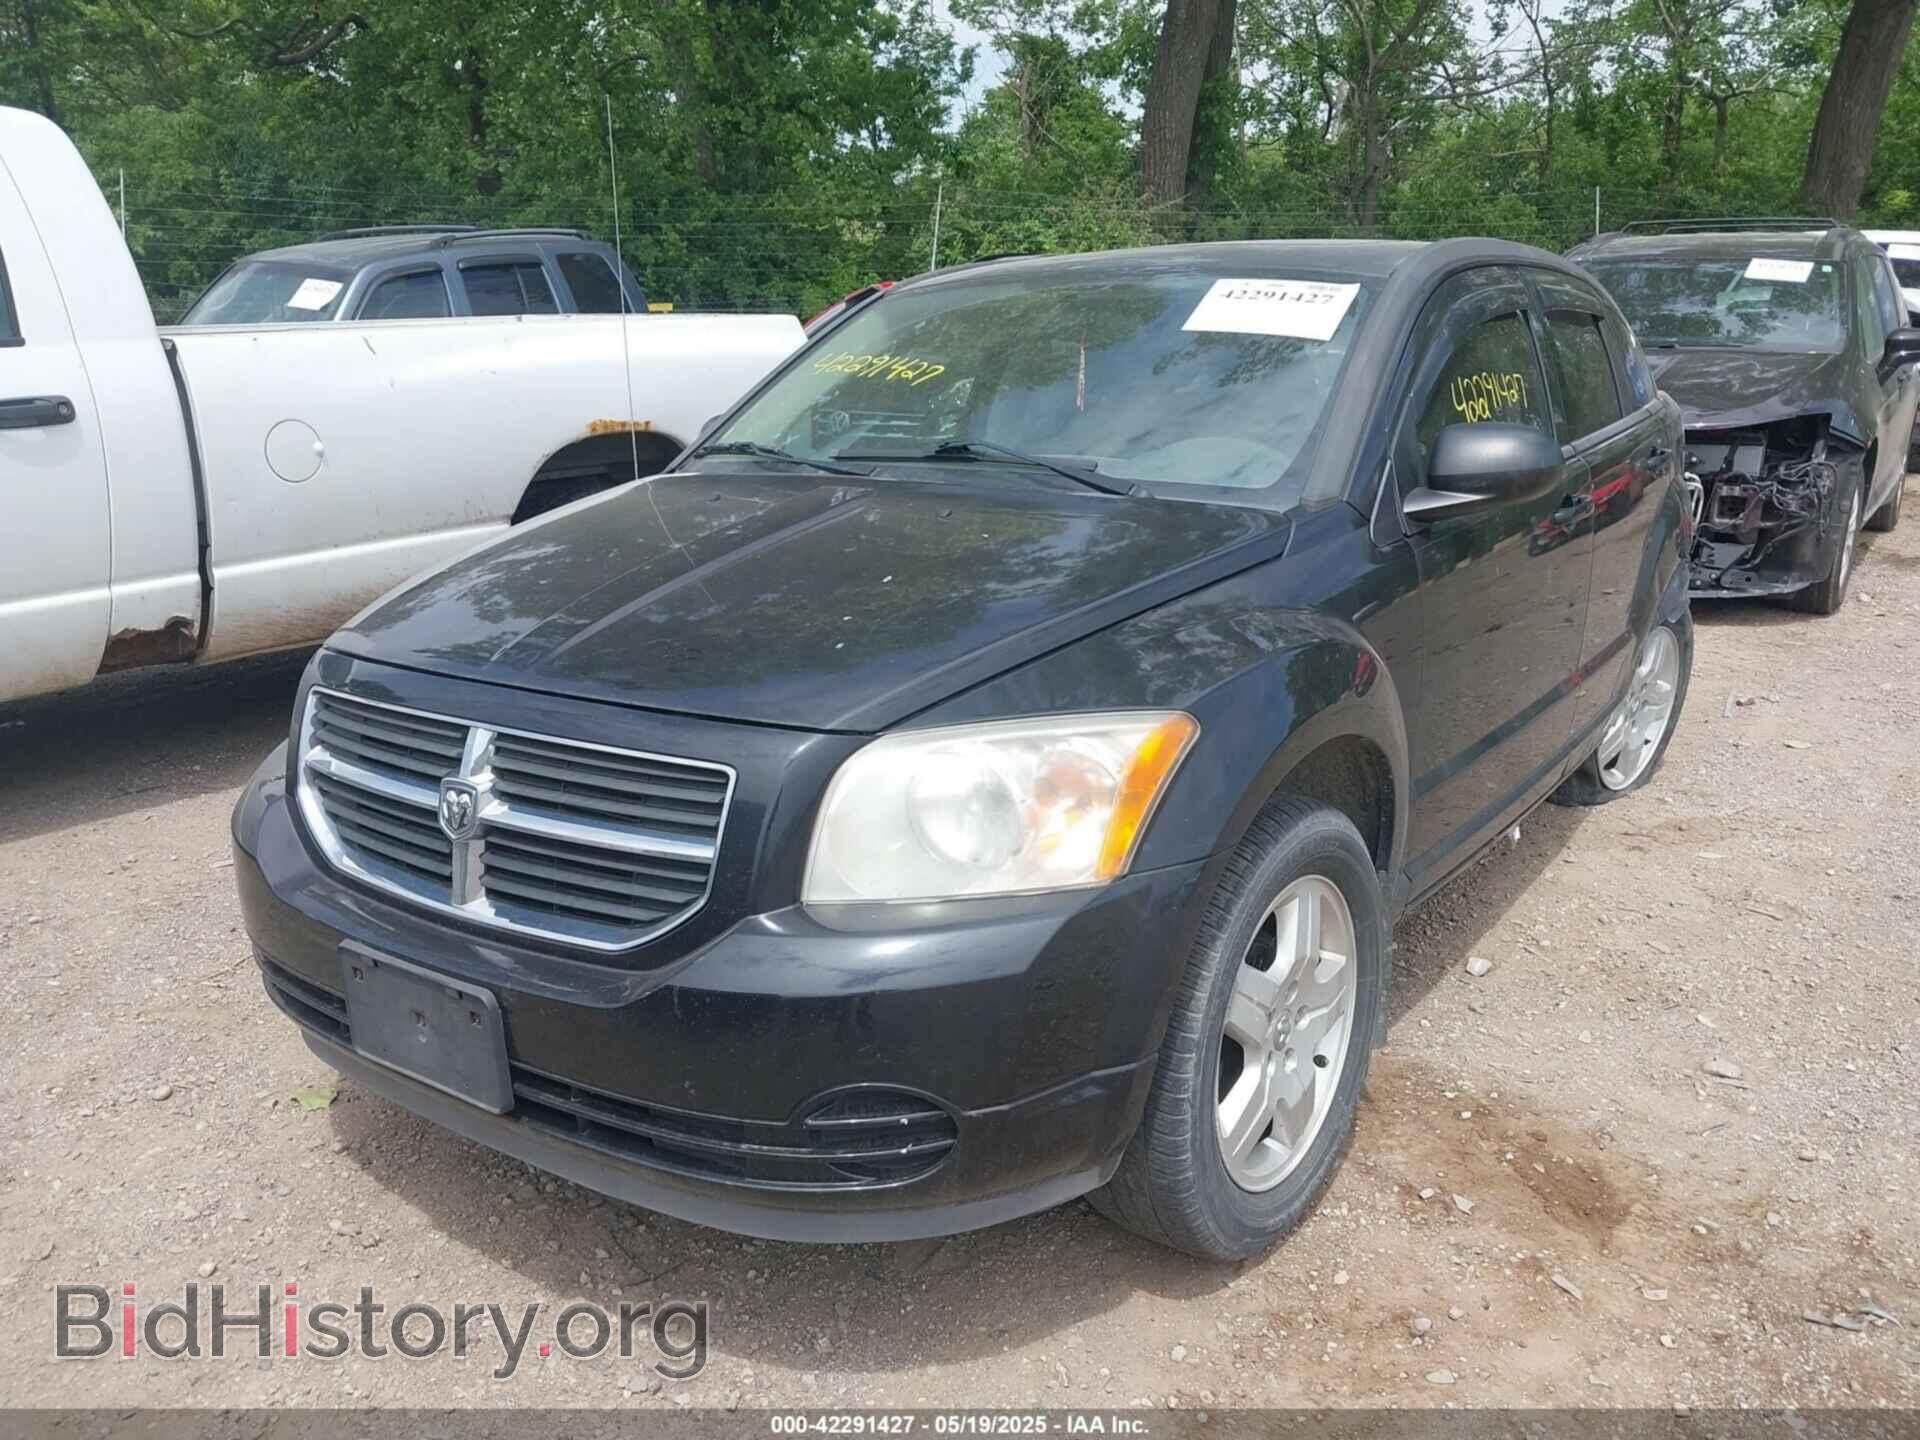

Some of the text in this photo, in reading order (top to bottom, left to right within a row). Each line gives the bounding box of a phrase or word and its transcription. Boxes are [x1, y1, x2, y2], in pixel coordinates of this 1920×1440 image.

[1219, 288, 1336, 304] 42291427
[814, 351, 945, 386] 42291427
[1450, 371, 1528, 423] 42291427
